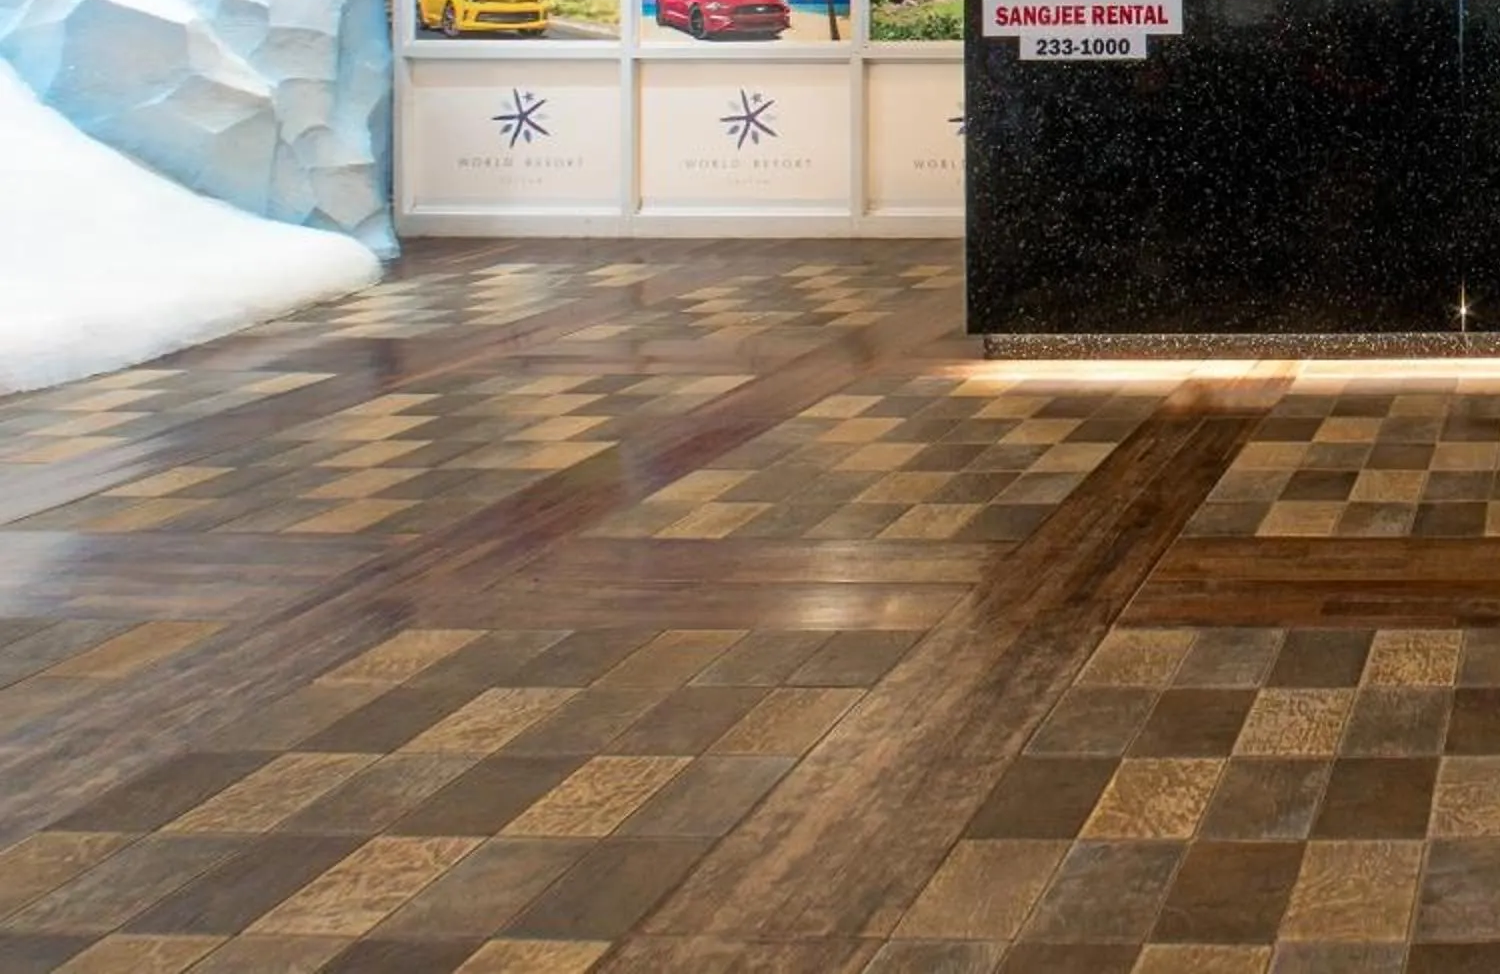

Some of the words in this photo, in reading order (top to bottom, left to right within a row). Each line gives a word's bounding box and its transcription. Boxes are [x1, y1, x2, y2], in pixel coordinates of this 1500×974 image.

[996, 6, 1085, 26] SANGJEE
[1092, 5, 1168, 24] RENTAL
[1036, 38, 1130, 55] 233-1000
